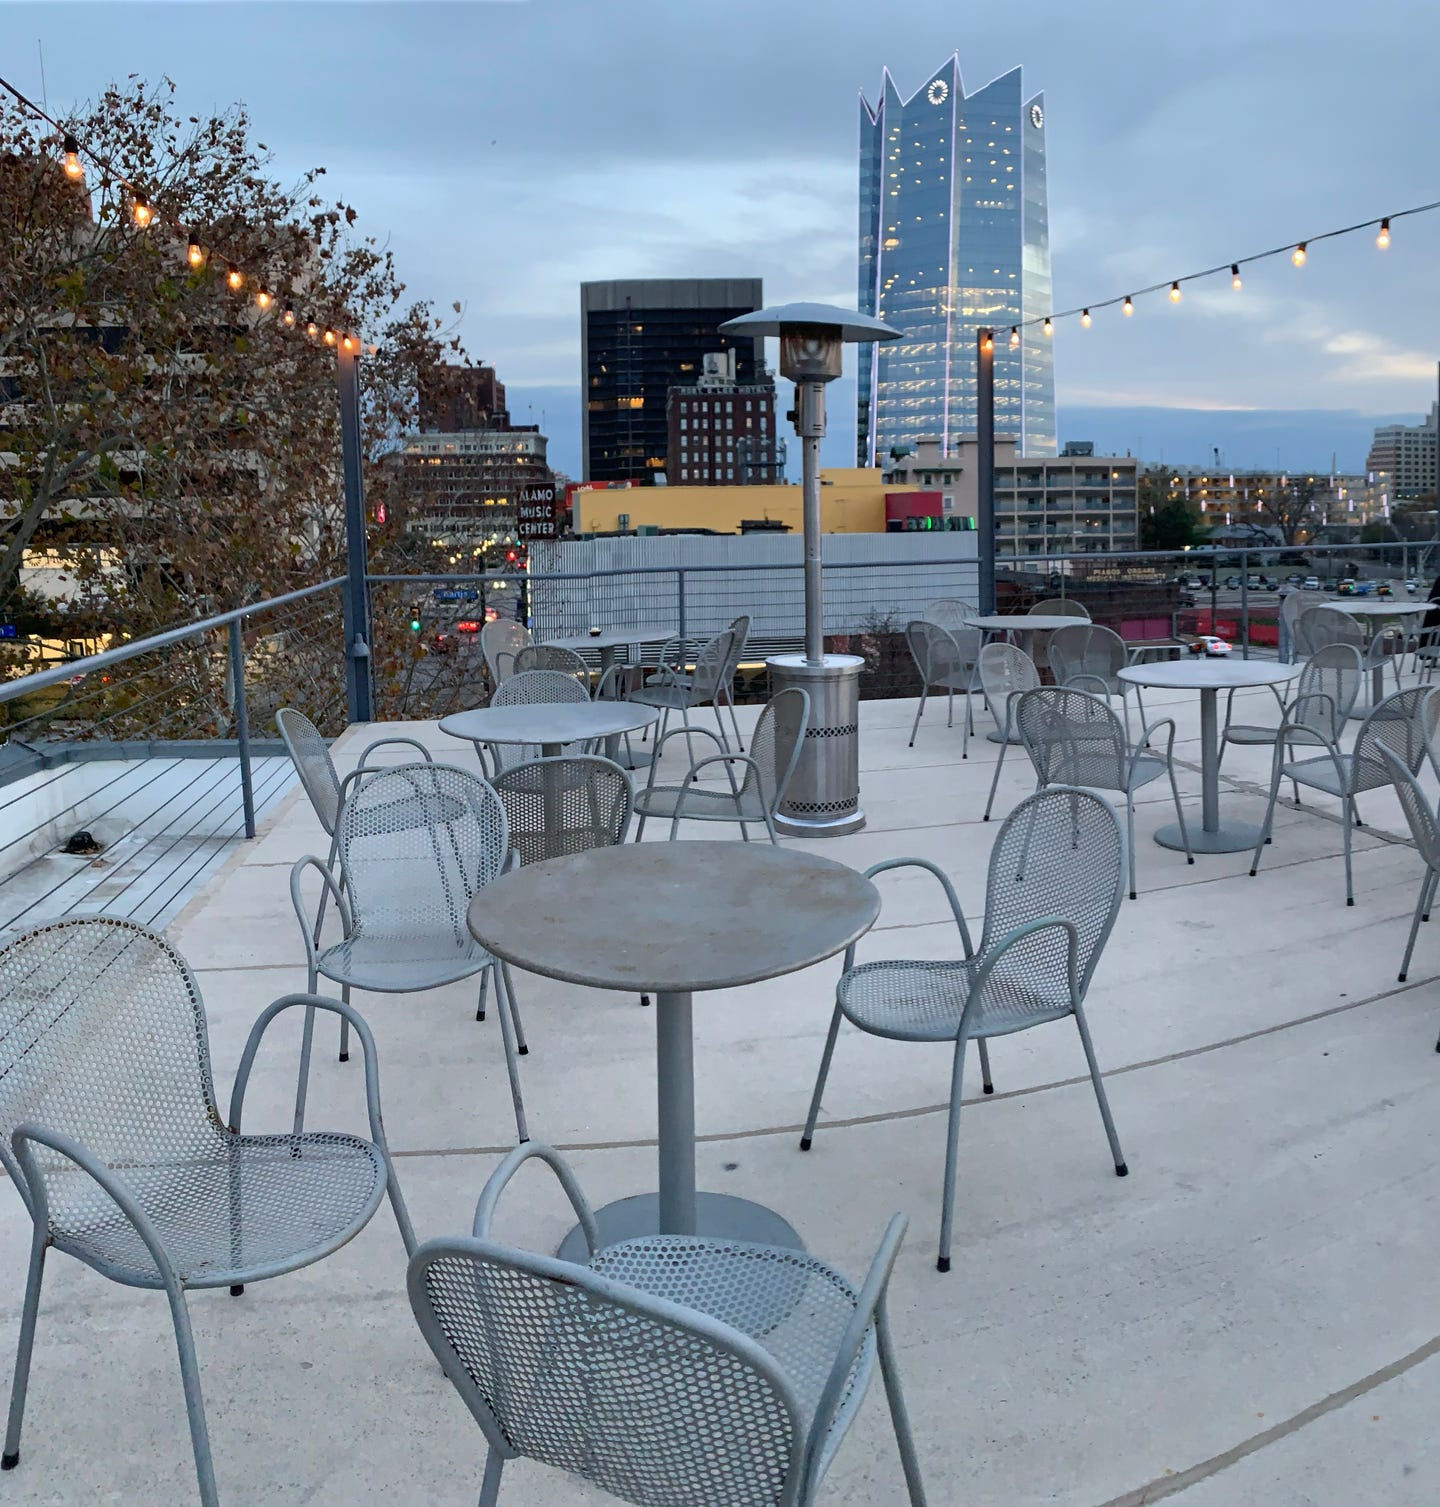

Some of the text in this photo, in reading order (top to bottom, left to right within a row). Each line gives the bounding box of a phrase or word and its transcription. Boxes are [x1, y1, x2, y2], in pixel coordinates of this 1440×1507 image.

[519, 489, 554, 501] ALAMO
[520, 506, 552, 518] MUSIC
[519, 522, 555, 534] CENTER
